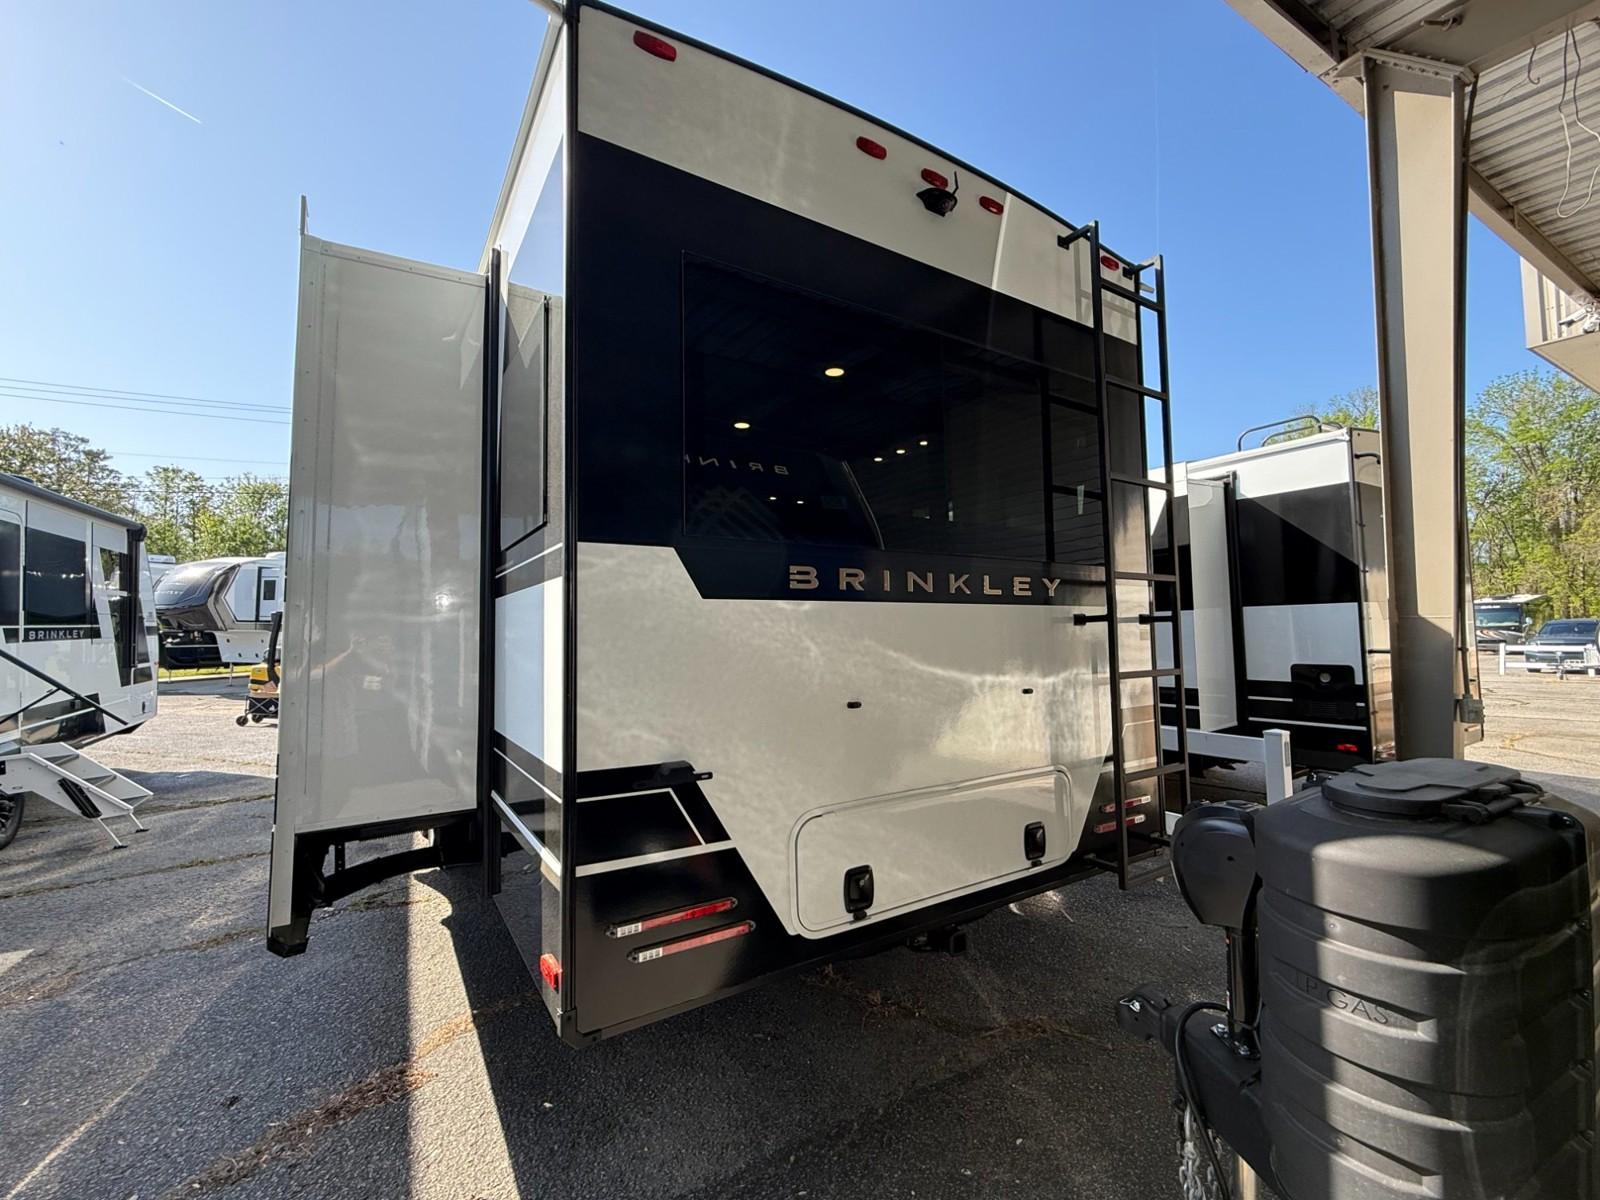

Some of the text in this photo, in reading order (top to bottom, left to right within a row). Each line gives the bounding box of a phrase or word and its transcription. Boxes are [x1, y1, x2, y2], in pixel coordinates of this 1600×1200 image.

[789, 565, 1061, 597] BRINKLEY
[28, 629, 85, 640] BRINKLEY
[1326, 988, 1388, 1025] GAS
